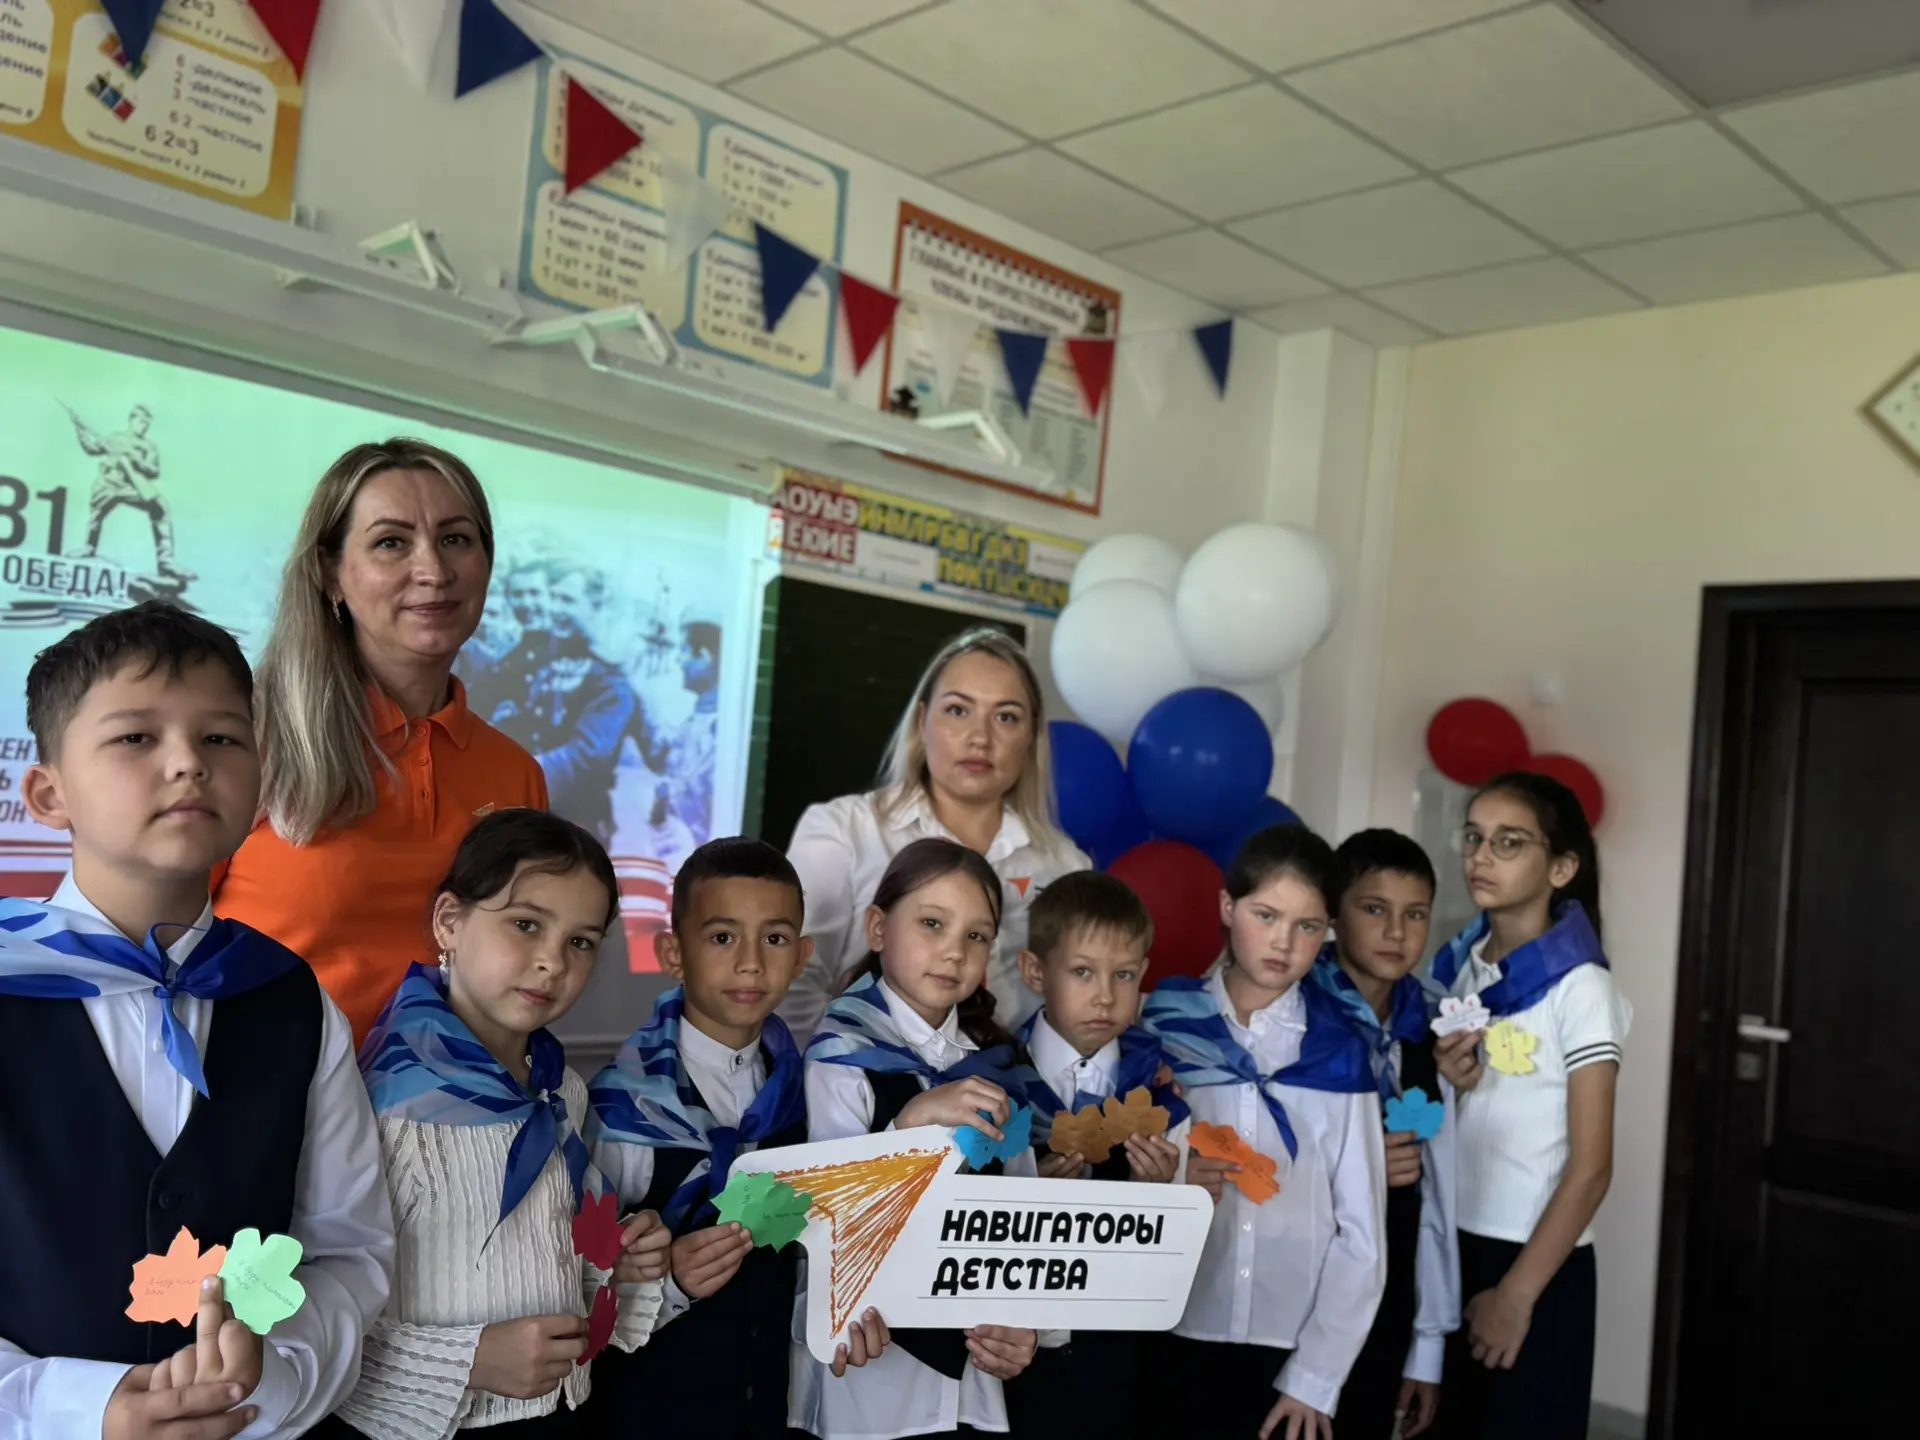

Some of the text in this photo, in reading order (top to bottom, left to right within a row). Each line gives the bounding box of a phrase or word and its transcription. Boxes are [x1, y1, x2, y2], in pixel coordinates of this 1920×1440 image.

[3, 554, 126, 599] ОБЕДА!
[940, 1209, 1165, 1245] НАВИГАТОРЫ
[930, 1257, 1089, 1296] ДЕТСТВА
